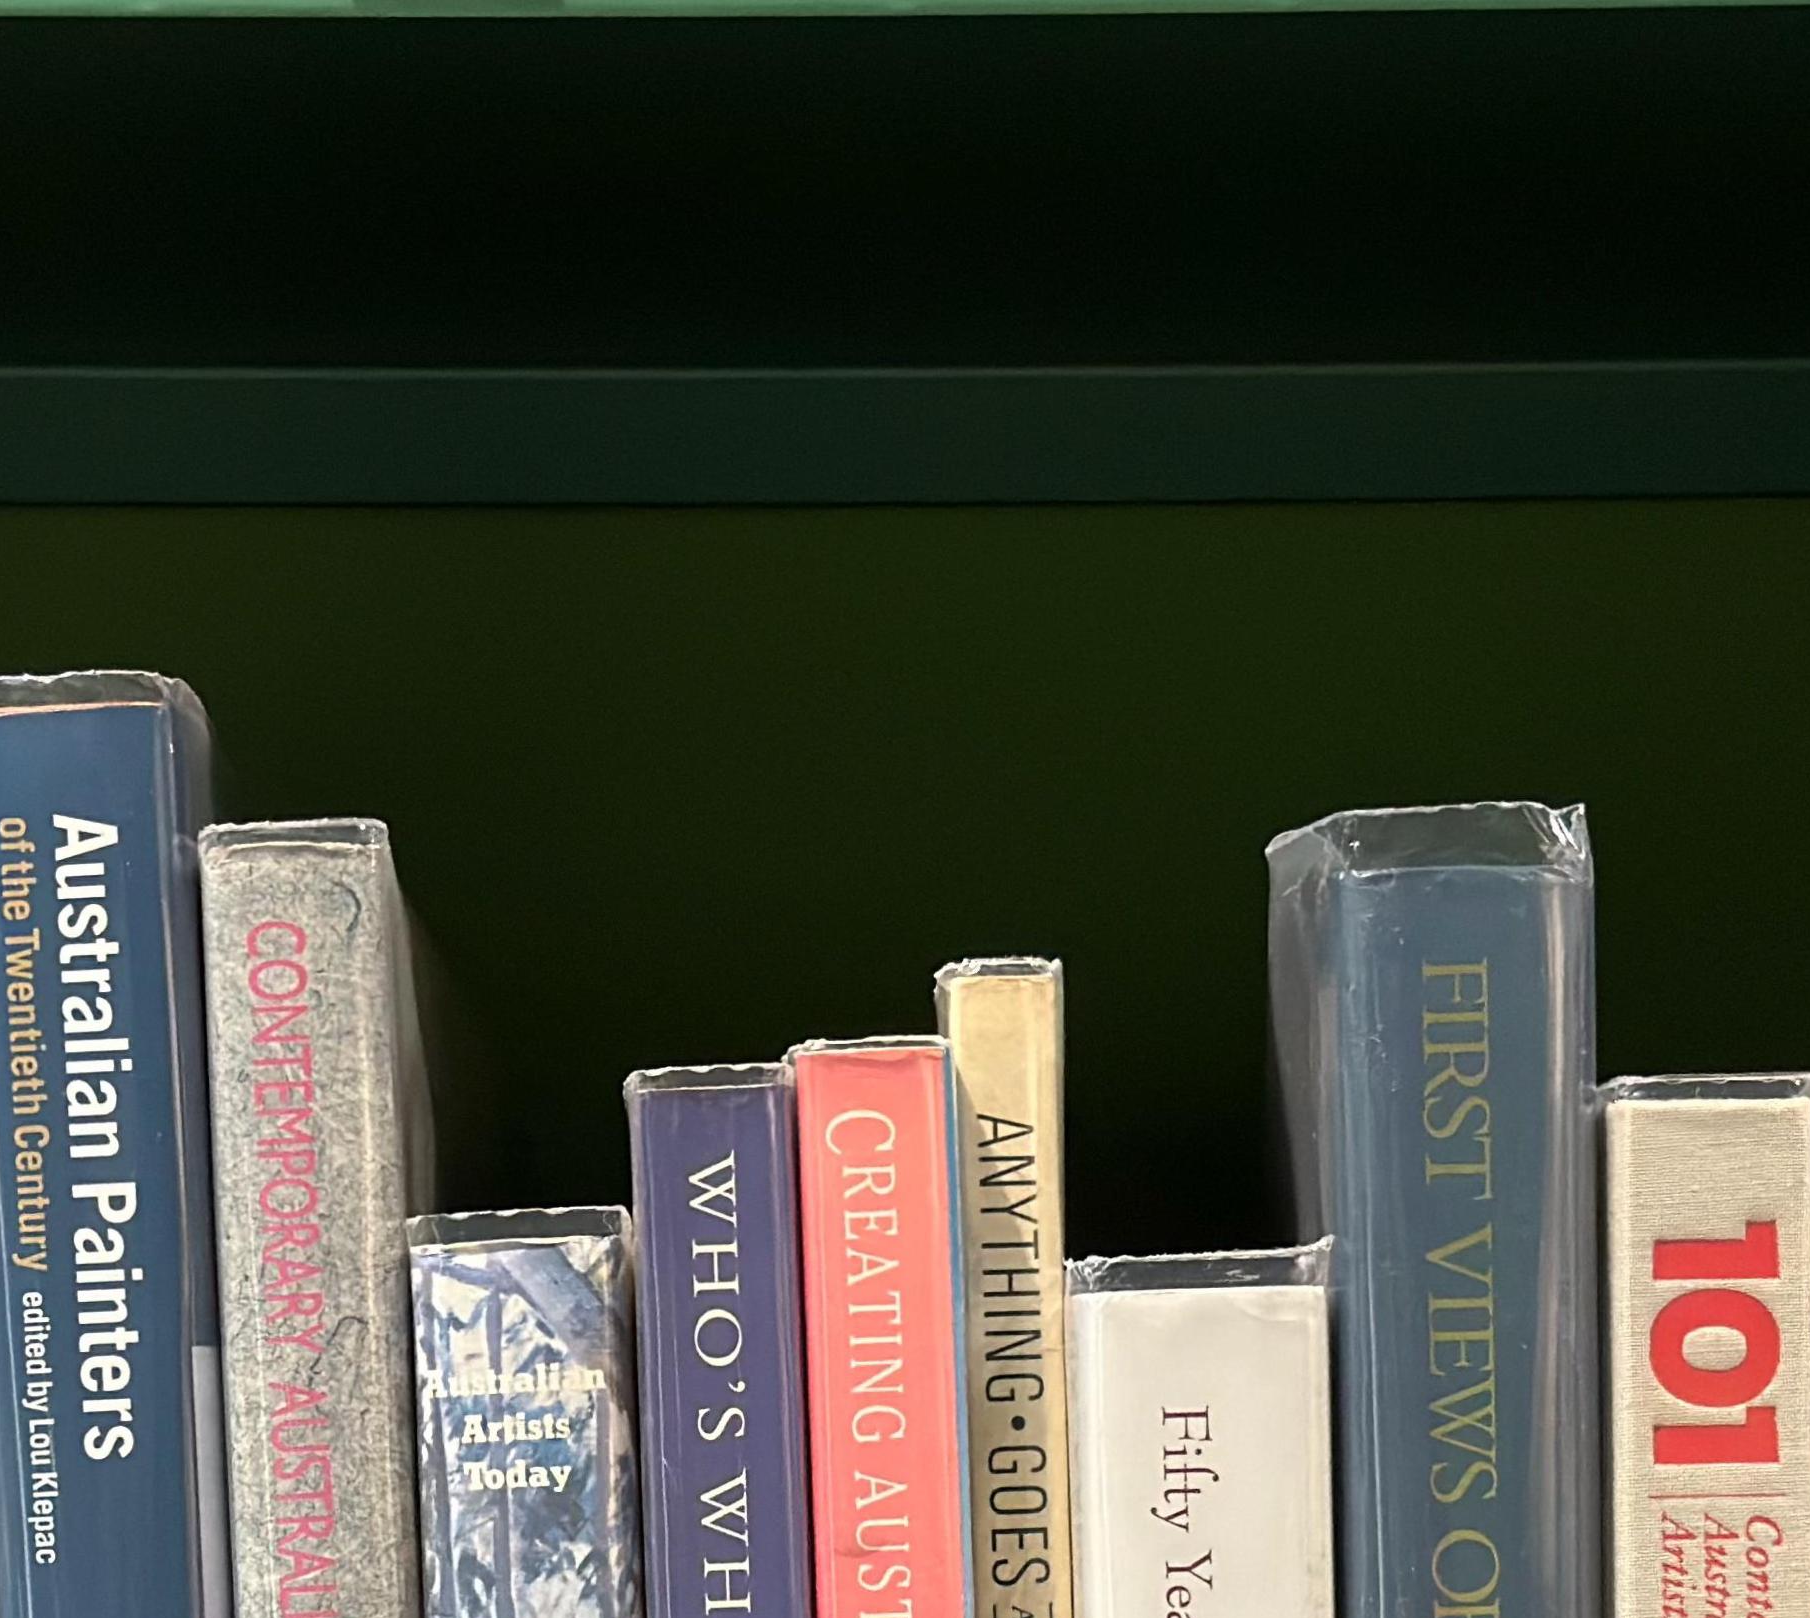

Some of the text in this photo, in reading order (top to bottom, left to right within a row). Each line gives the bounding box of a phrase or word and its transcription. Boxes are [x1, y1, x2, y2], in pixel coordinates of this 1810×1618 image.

[0, 819, 59, 1564] of the Twentieth Century edited by Lou Klepac
[52, 813, 140, 1460] Australian Painters
[246, 921, 321, 1354] CONTEMPORARY
[1422, 959, 1494, 1201] FIRST
[825, 1108, 907, 1444] CREATING
[1427, 1223, 1497, 1503] VIEWS
[1648, 1219, 1781, 1466] 101
[460, 1413, 570, 1442] Artists
[463, 1460, 572, 1492] Today
[1150, 1405, 1217, 1534] Fifty
